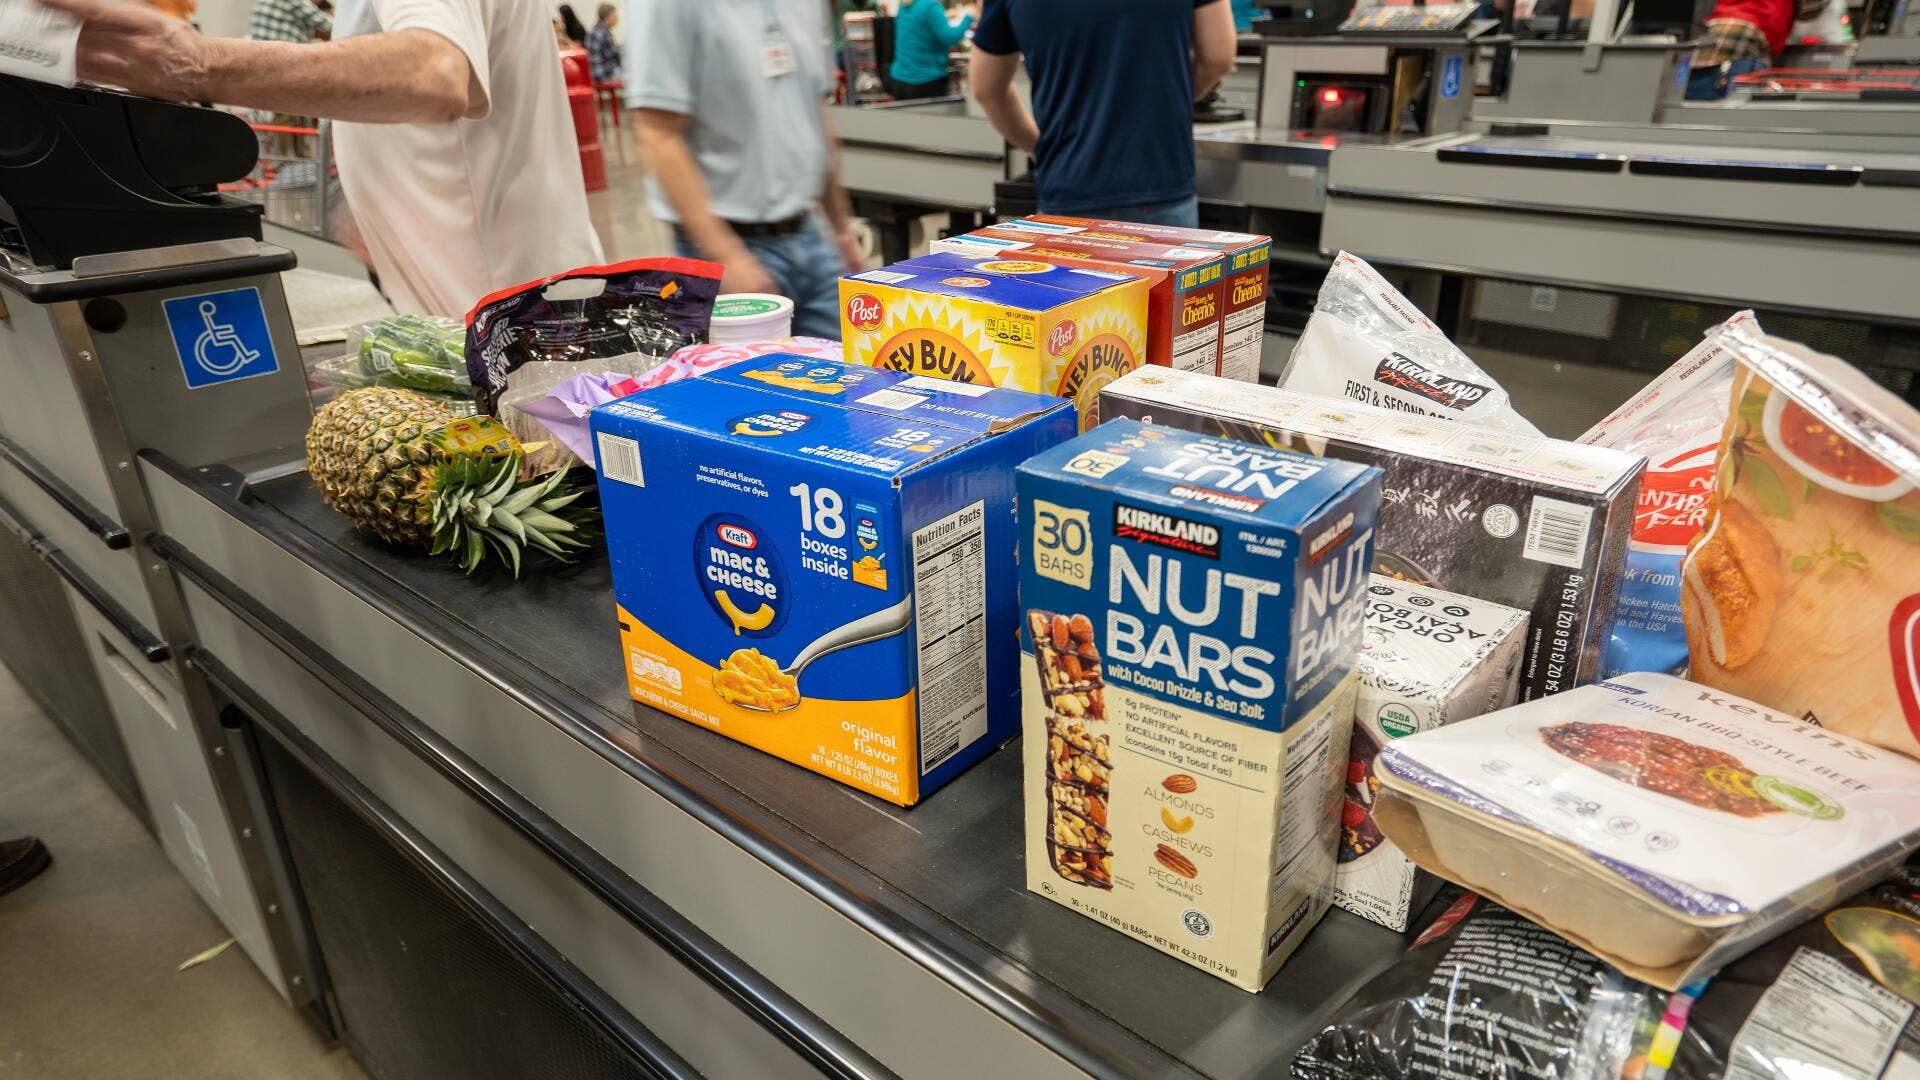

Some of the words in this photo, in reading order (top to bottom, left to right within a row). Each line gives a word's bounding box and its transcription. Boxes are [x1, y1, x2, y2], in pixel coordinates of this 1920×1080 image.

[1232, 282, 1263, 306] Cheerios
[849, 297, 880, 322] Post
[1182, 301, 1215, 327] Cheerios
[1051, 325, 1074, 352] Post
[1383, 353, 1490, 403] KIRKLAND
[1678, 353, 1713, 381] RESEALABLE
[1344, 380, 1372, 405] FIRST
[1372, 391, 1380, 406] &
[1383, 396, 1426, 418] SECOND
[1644, 391, 1661, 407] OPEN
[893, 428, 931, 442] 18
[1069, 458, 1106, 475] 30
[1182, 442, 1323, 481] BARS
[696, 474, 743, 493] preservatives,
[743, 484, 752, 493] or
[752, 487, 769, 498] dyes
[699, 464, 709, 473] no
[708, 465, 737, 480] artificial
[736, 471, 765, 487] flavors,
[1141, 464, 1300, 500] NUT
[789, 482, 847, 539] 18
[1169, 486, 1260, 513] KIRKLAND
[725, 528, 750, 546] Kraft
[916, 522, 956, 548] Nutrition
[959, 508, 982, 527] Facts
[1037, 511, 1088, 556] 30
[1116, 506, 1220, 547] KIRKLAND
[1308, 511, 1357, 557] KIRKLAND
[801, 532, 848, 561] boxes
[951, 548, 964, 563] 250
[969, 539, 982, 553] 350
[1115, 525, 1218, 557] Signature
[1527, 533, 1538, 551] ITEM
[709, 546, 754, 574] mac
[754, 556, 771, 580] &
[801, 552, 849, 580] inside
[917, 565, 939, 580] Calories
[1040, 554, 1085, 580] BARS
[1298, 526, 1374, 632] NUT
[1564, 573, 1585, 588] kg
[1640, 568, 1676, 588] from
[1109, 544, 1281, 640] NUT
[1560, 588, 1578, 609] 1.53
[1557, 610, 1576, 630] OZ)
[1617, 618, 1627, 628] in
[1628, 619, 1645, 630] the
[1647, 621, 1668, 632] USA
[1630, 609, 1648, 619] and
[1296, 588, 1366, 682] BARS
[1552, 638, 1568, 652] LB
[1555, 630, 1569, 638] 6
[1106, 608, 1276, 701] BARS
[1549, 654, 1565, 664] (3
[1527, 658, 1539, 679] Enlarged
[1547, 665, 1564, 679] OZ
[1107, 663, 1132, 681] with
[1132, 669, 1164, 693] Cocoa
[1165, 677, 1202, 703] Drizzle
[1203, 691, 1215, 706] &
[1215, 694, 1239, 713] Sea
[1238, 700, 1266, 721] Salt
[1545, 680, 1560, 692] 54
[668, 699, 690, 715] CHEESE
[689, 706, 709, 722] SAUCE
[708, 714, 721, 726] MIX
[1387, 709, 1412, 724] USDA
[841, 720, 897, 750] original
[1125, 711, 1139, 722] NO
[1141, 714, 1190, 738] ARTIFICIAL
[1193, 731, 1238, 752] FLAVORS
[1379, 718, 1417, 736] ORGANIC
[1697, 690, 1877, 763] kevins
[853, 737, 897, 766] flavor
[1125, 723, 1177, 748] EXCELLENT
[1179, 738, 1218, 760] SOURCE
[1220, 752, 1235, 765] OF
[1237, 756, 1268, 774] FIBER
[1125, 735, 1167, 757] (contains
[1186, 755, 1210, 773] Total
[1211, 762, 1233, 779] Fat)
[1620, 697, 1701, 729] KOREAN
[1698, 721, 1815, 768] BBQ-STYLE
[1814, 765, 1869, 793] BEEF
[811, 752, 824, 766] NET
[825, 759, 837, 770] WT
[842, 765, 852, 776] LB
[852, 768, 863, 780] 2.5
[863, 773, 873, 784] OZ
[844, 755, 854, 766] OZ
[874, 766, 899, 784] BOXES
[1143, 786, 1216, 821] ALMONDS
[1142, 823, 1214, 859] CASHEWS
[1148, 865, 1204, 897] PECANS
[1368, 900, 1392, 918] 1.06kg
[1084, 903, 1099, 919] 1.41
[1099, 909, 1109, 921] OZ
[1109, 913, 1121, 928] (40
[1153, 934, 1168, 950] NET
[1168, 941, 1181, 954] WT
[1180, 946, 1198, 961] 42.3
[1197, 954, 1209, 968] OZ
[1208, 958, 1224, 973] (1.2
[1224, 964, 1239, 979] kg)
[1502, 1015, 1554, 1041] microwave
